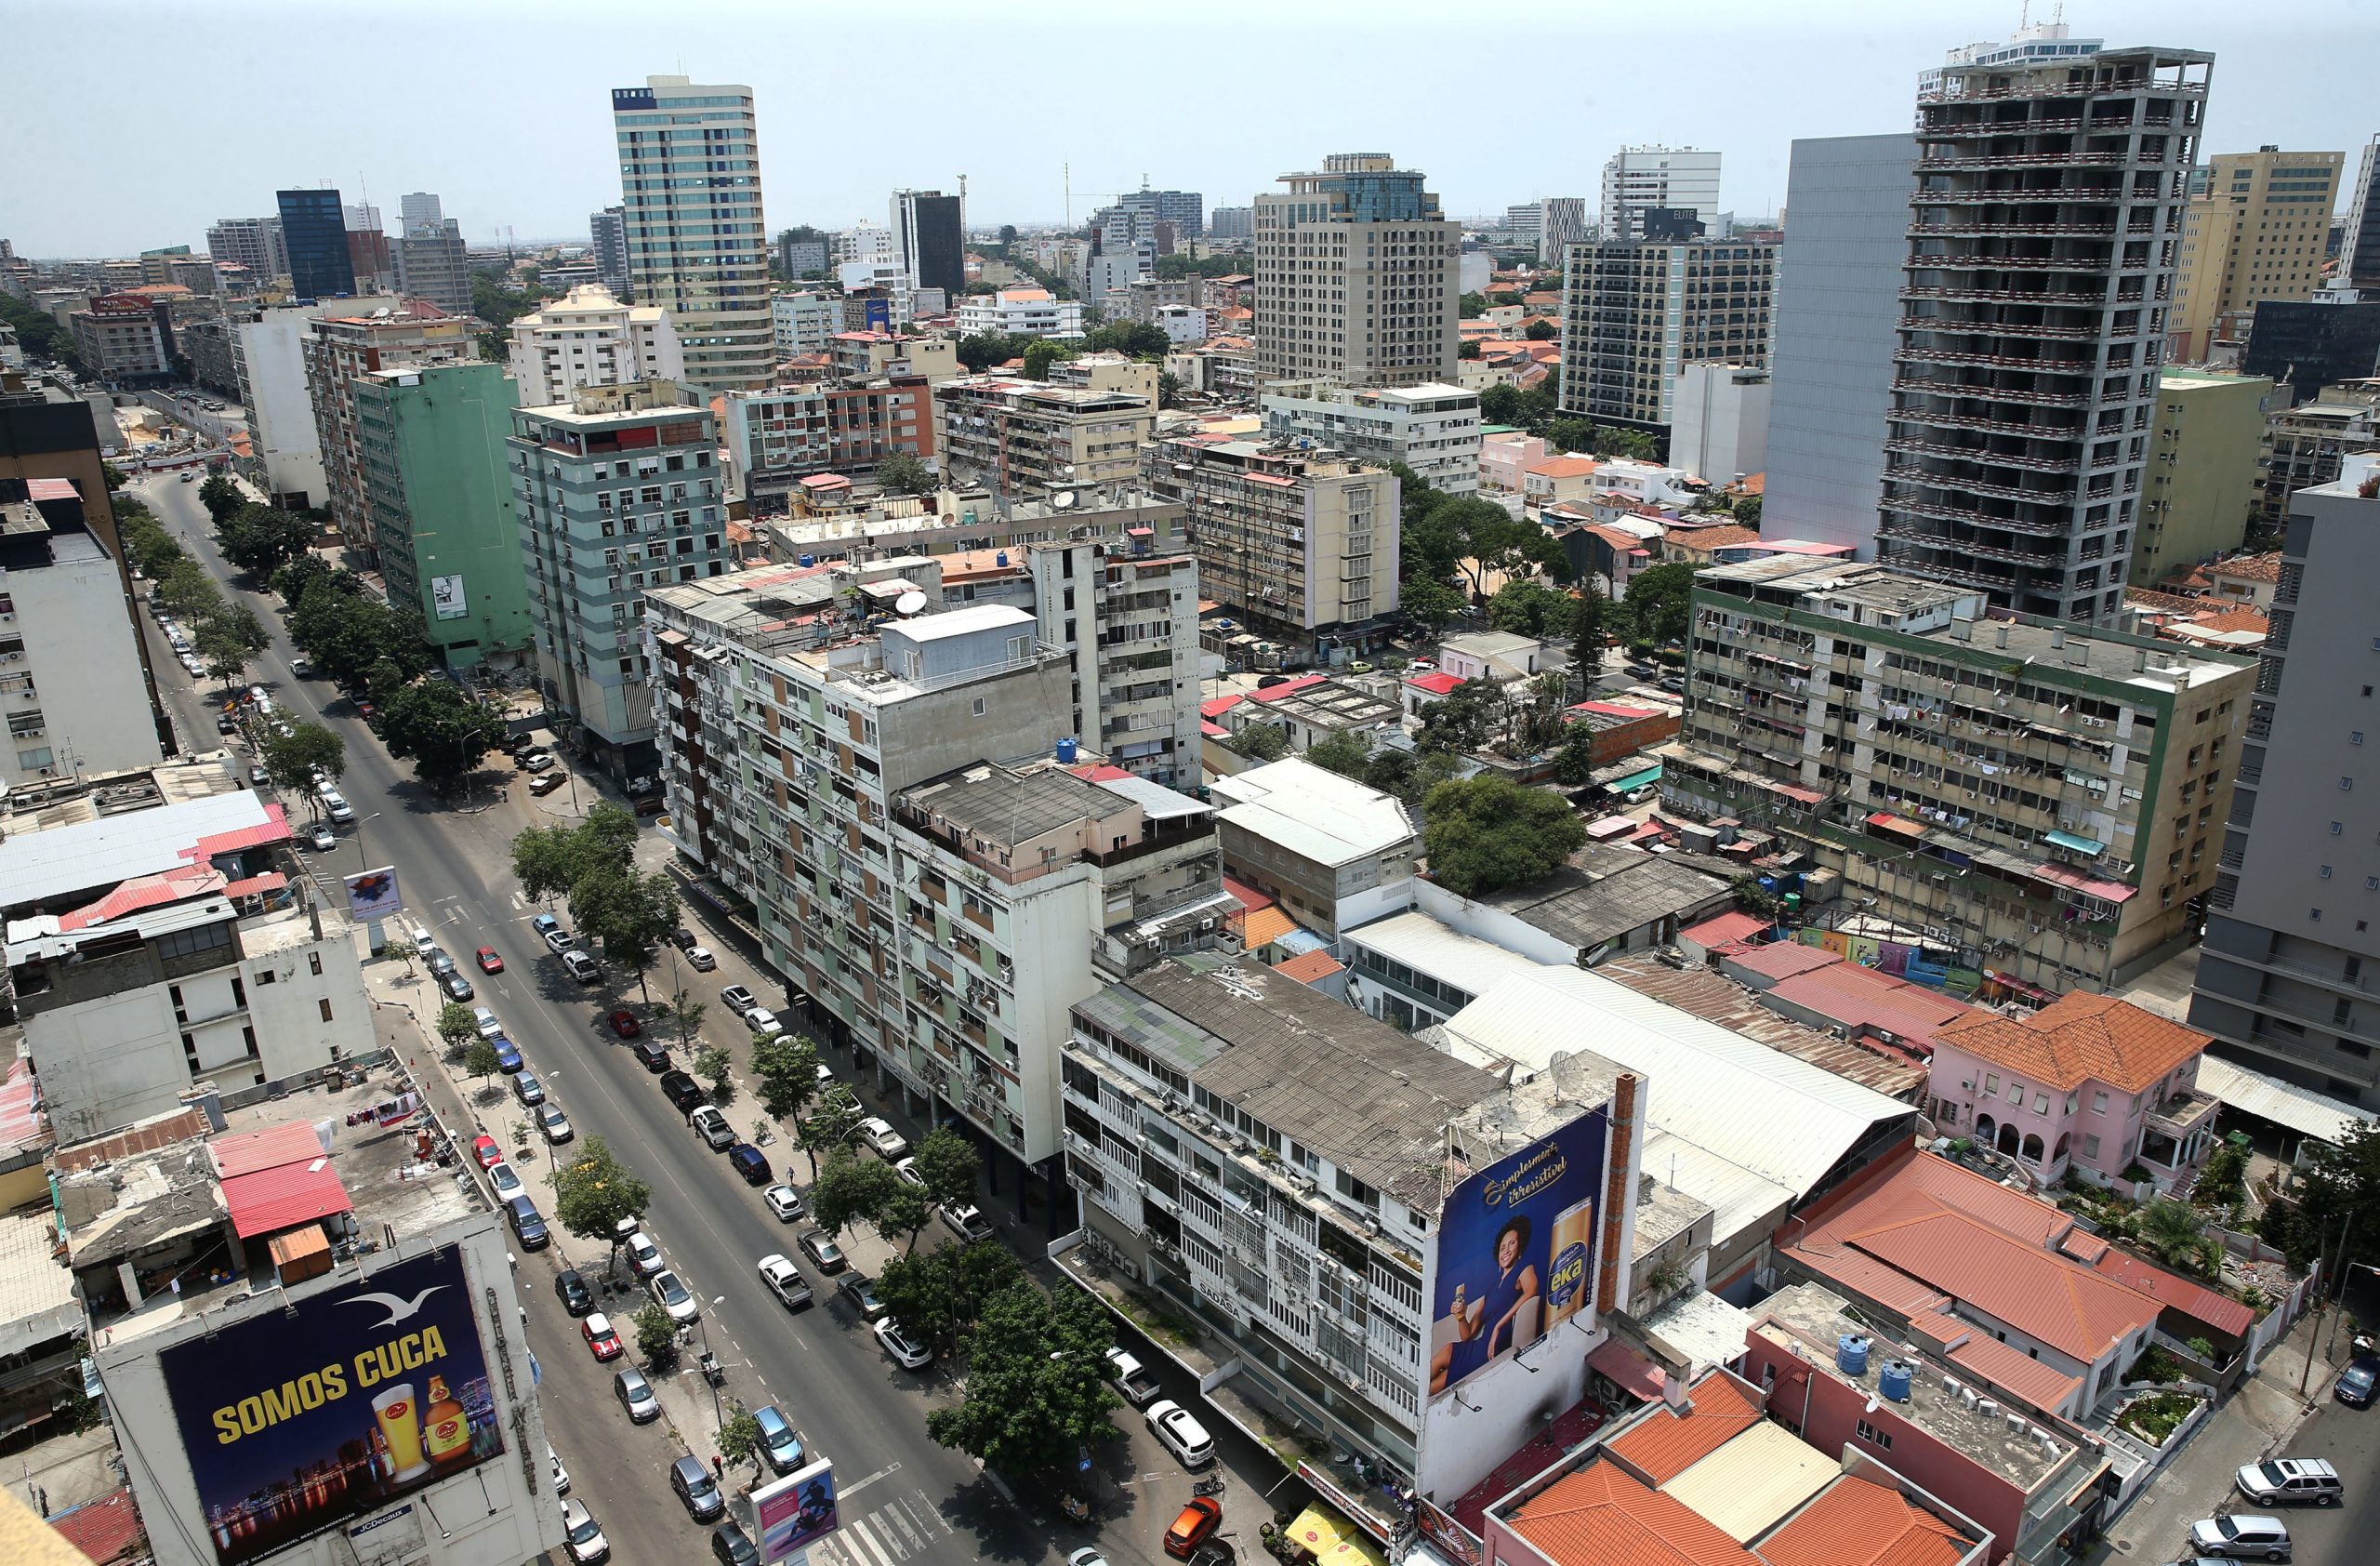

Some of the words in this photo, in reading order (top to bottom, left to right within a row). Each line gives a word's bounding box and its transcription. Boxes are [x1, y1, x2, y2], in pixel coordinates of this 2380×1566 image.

[1673, 209, 1694, 220] ELITE
[212, 1363, 348, 1444] SOMOS
[353, 1325, 447, 1387] CUCA
[251, 1553, 264, 1562] SEJA
[325, 1512, 355, 1529] MODERAÇÃO
[360, 1509, 403, 1533] JCDecaux
